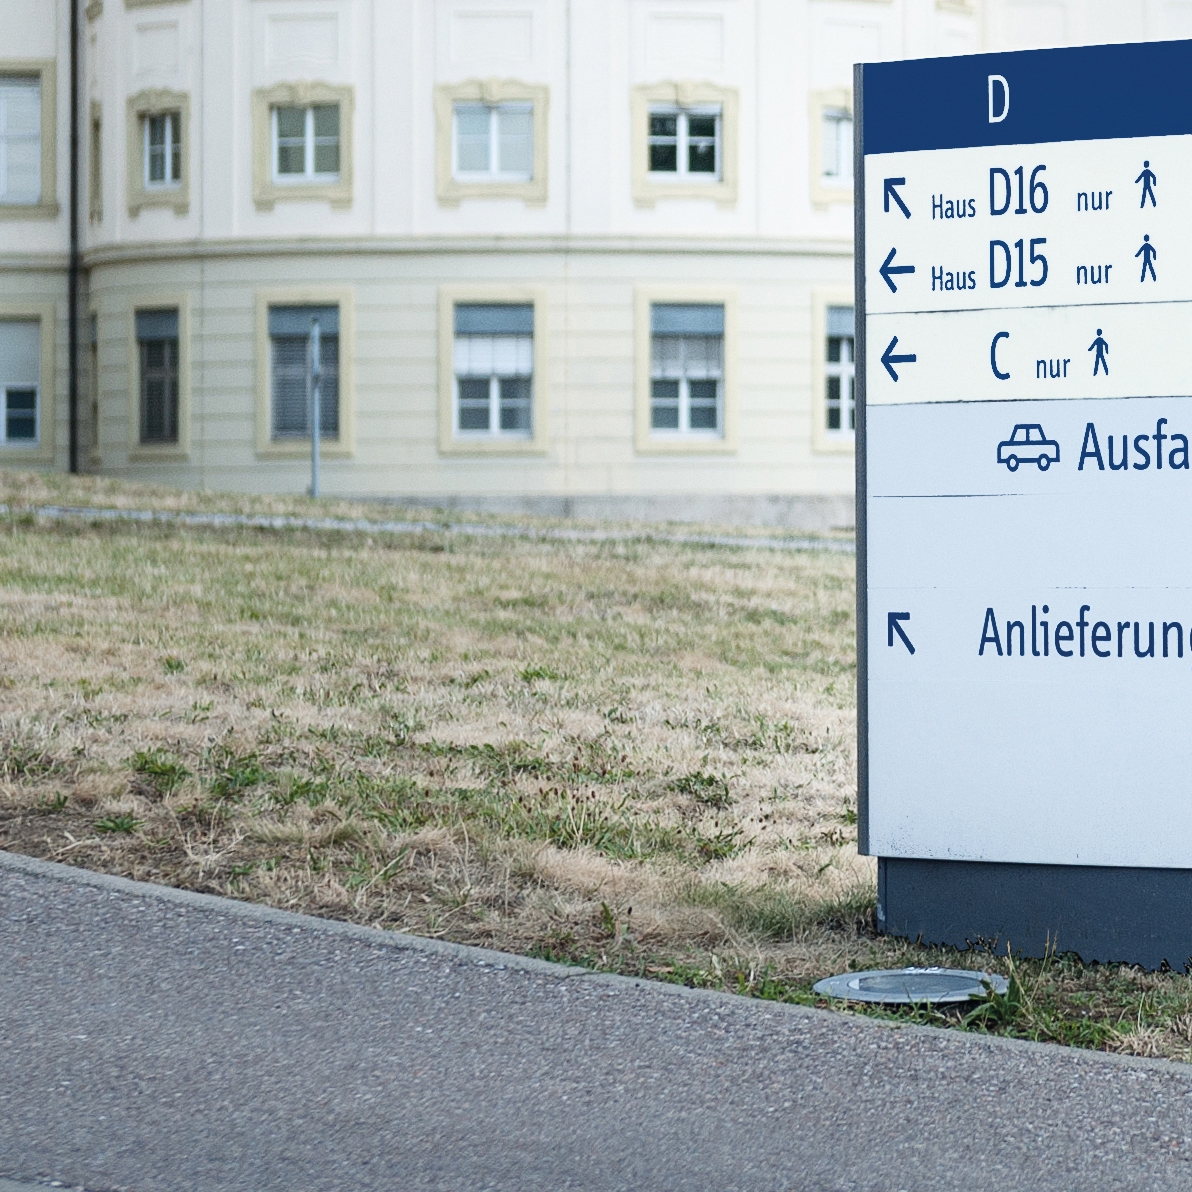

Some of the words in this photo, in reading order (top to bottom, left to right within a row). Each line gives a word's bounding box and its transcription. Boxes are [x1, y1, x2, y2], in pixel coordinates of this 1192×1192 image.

[988, 74, 1011, 124] D
[931, 193, 977, 221] Haus
[989, 164, 1049, 217] D16
[1077, 190, 1113, 212] nur
[931, 265, 977, 292] Haus
[989, 237, 1049, 289] D15
[1076, 264, 1113, 286] nur
[990, 331, 1011, 381] C
[1036, 358, 1071, 379] nur
